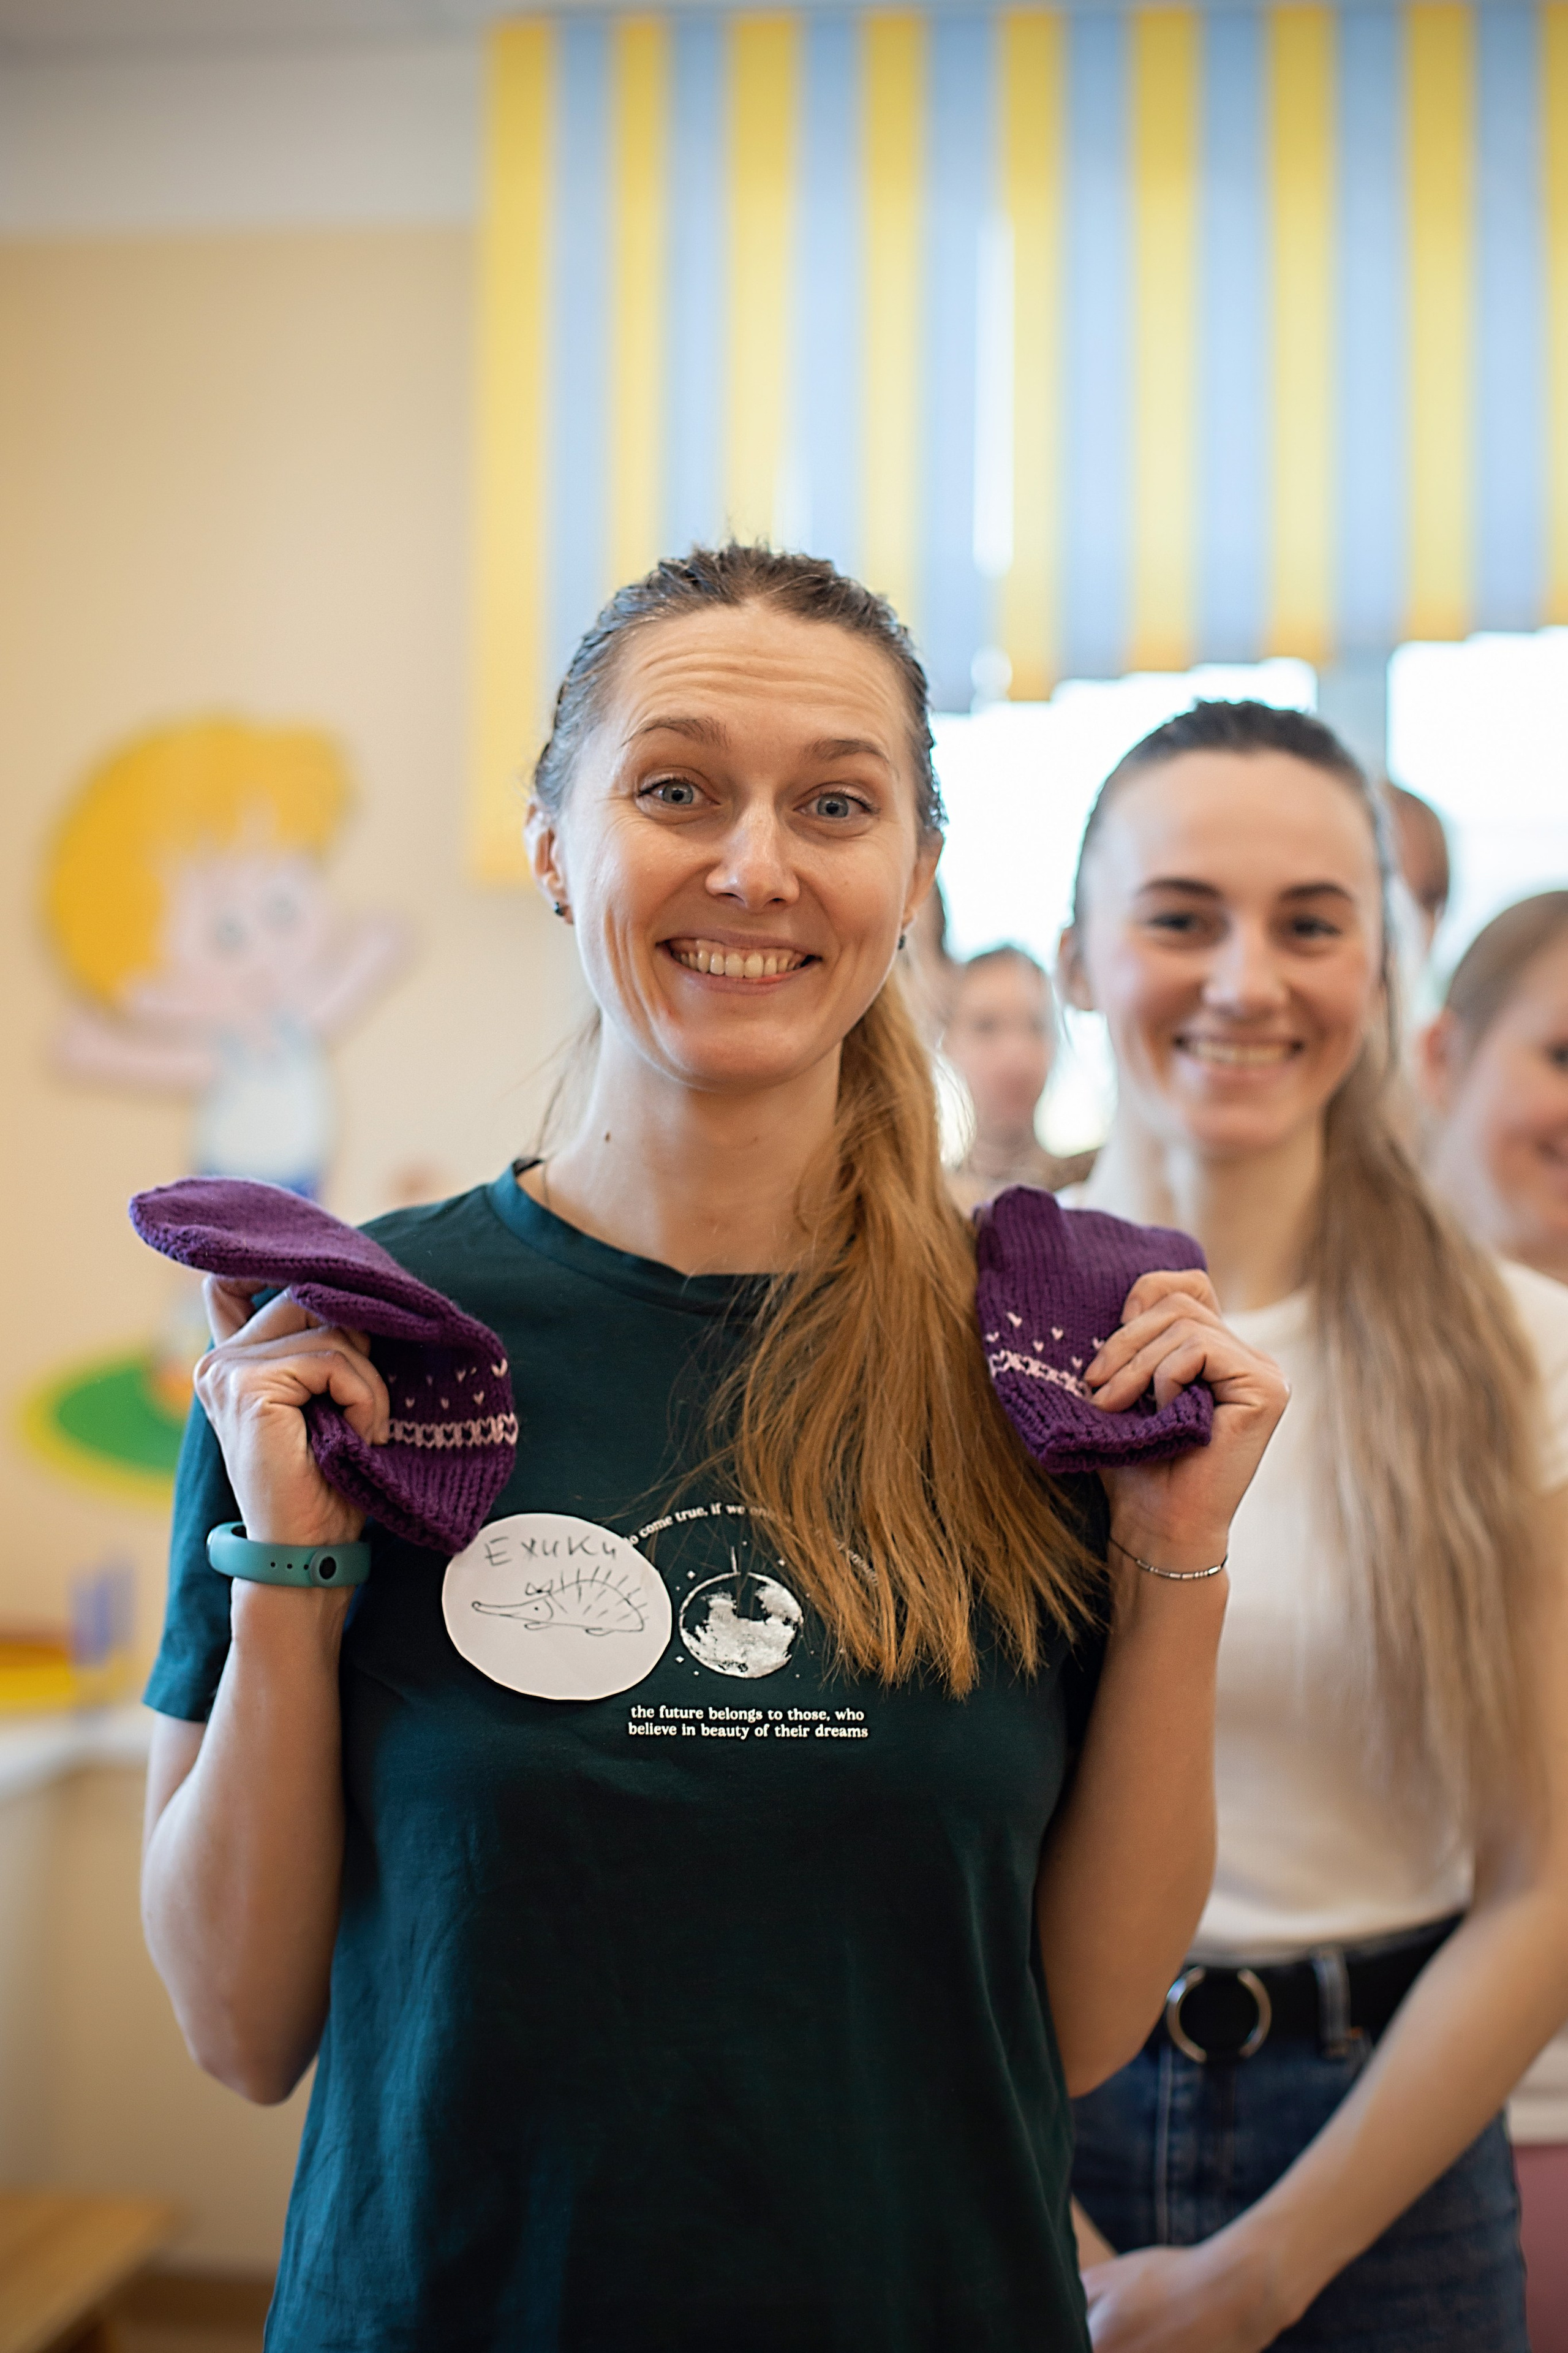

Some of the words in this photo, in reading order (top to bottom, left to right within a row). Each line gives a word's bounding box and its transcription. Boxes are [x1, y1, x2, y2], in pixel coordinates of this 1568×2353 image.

[639, 1516, 673, 1538] come
[674, 1507, 708, 1522] true,
[710, 1503, 722, 1515] if
[726, 1505, 745, 1514] we
[631, 1705, 655, 1718] the
[659, 1705, 704, 1720] future
[708, 1707, 763, 1723] belongs
[767, 1710, 783, 1720] to
[787, 1707, 831, 1721] those,
[835, 1707, 865, 1721] who
[628, 1721, 677, 1735] believe
[682, 1723, 696, 1736] in
[701, 1723, 750, 1740] beauty
[754, 1723, 770, 1737] of
[774, 1723, 810, 1737] their
[815, 1723, 869, 1738] dreams
